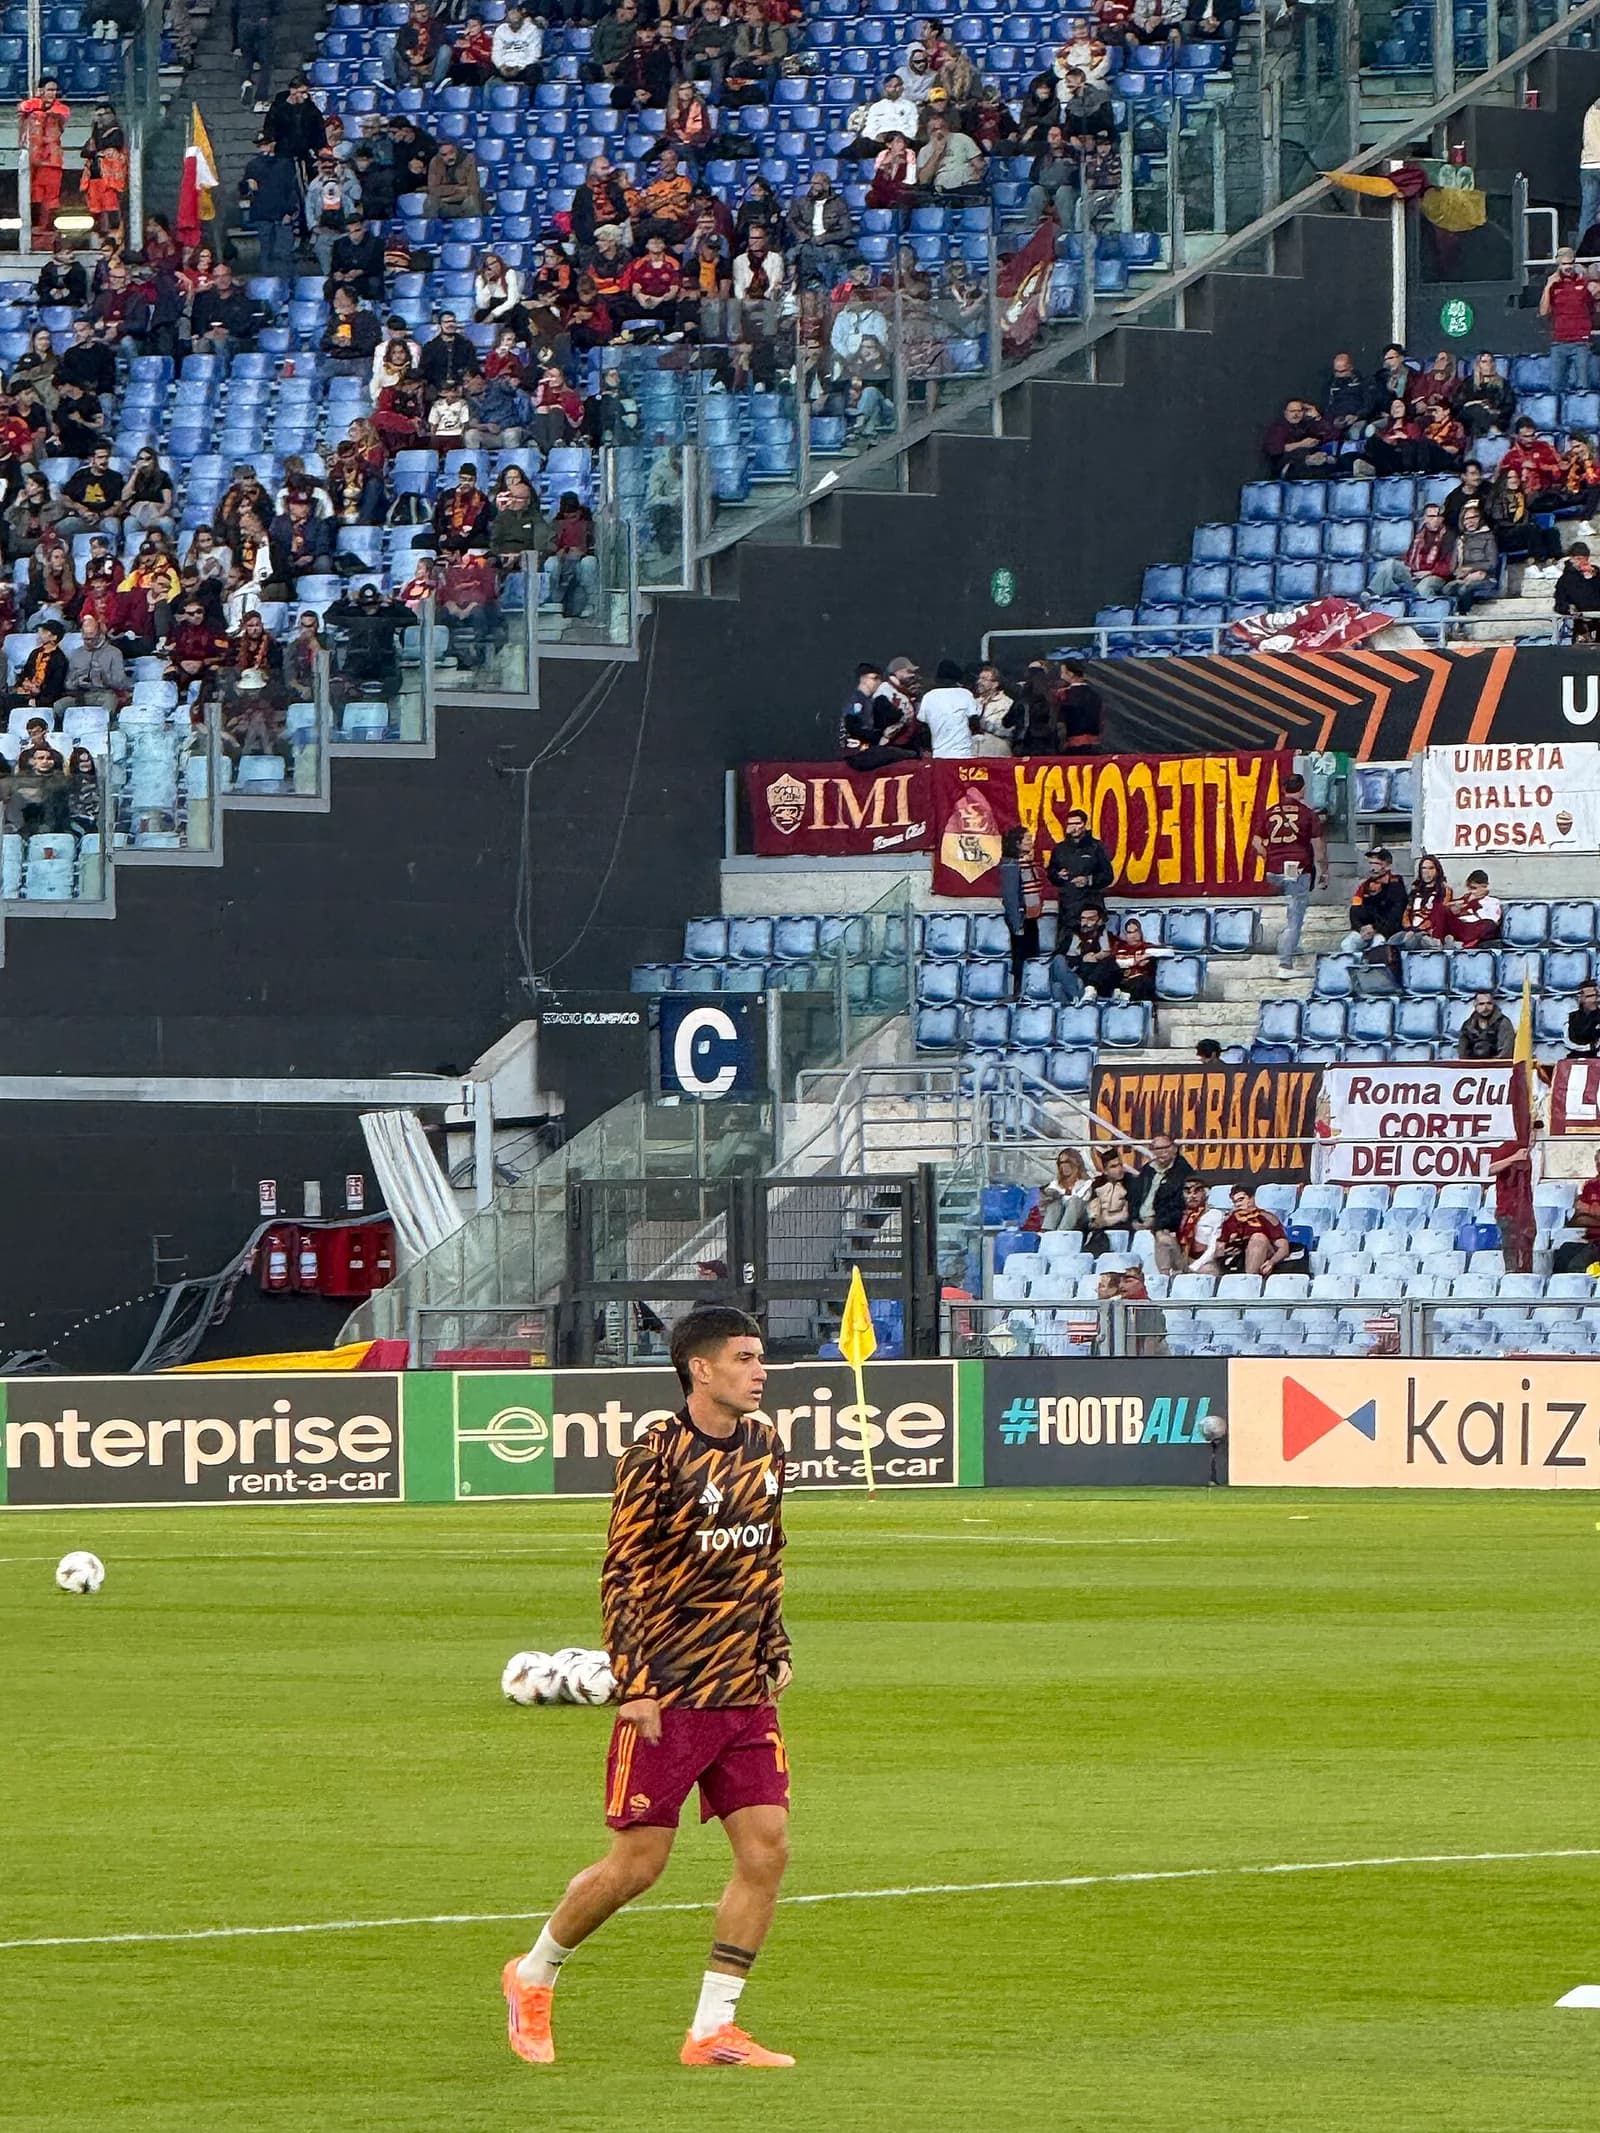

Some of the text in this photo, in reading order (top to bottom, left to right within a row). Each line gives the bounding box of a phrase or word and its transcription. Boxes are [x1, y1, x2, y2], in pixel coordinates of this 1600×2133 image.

[1562, 675, 1599, 725] U
[1454, 747, 1565, 773] UMBRIA
[807, 774, 914, 830] IMI
[1455, 784, 1553, 809] GIALLO
[1455, 822, 1546, 847] ROSSA
[674, 1007, 737, 1100] C
[1348, 1076, 1441, 1105] Roma
[1565, 1065, 1600, 1120] L
[1379, 1112, 1492, 1138] CORTE
[1352, 1145, 1402, 1177] DEI
[485, 1386, 946, 1465] entrise
[999, 1396, 1211, 1445] #FOOTBALL
[1407, 1377, 1600, 1467] kaiz
[0, 1399, 392, 1484] nterprise
[228, 1469, 392, 1494] rent-a-car
[784, 1455, 944, 1482] ent-a-car
[766, 1732, 789, 1773] 1
